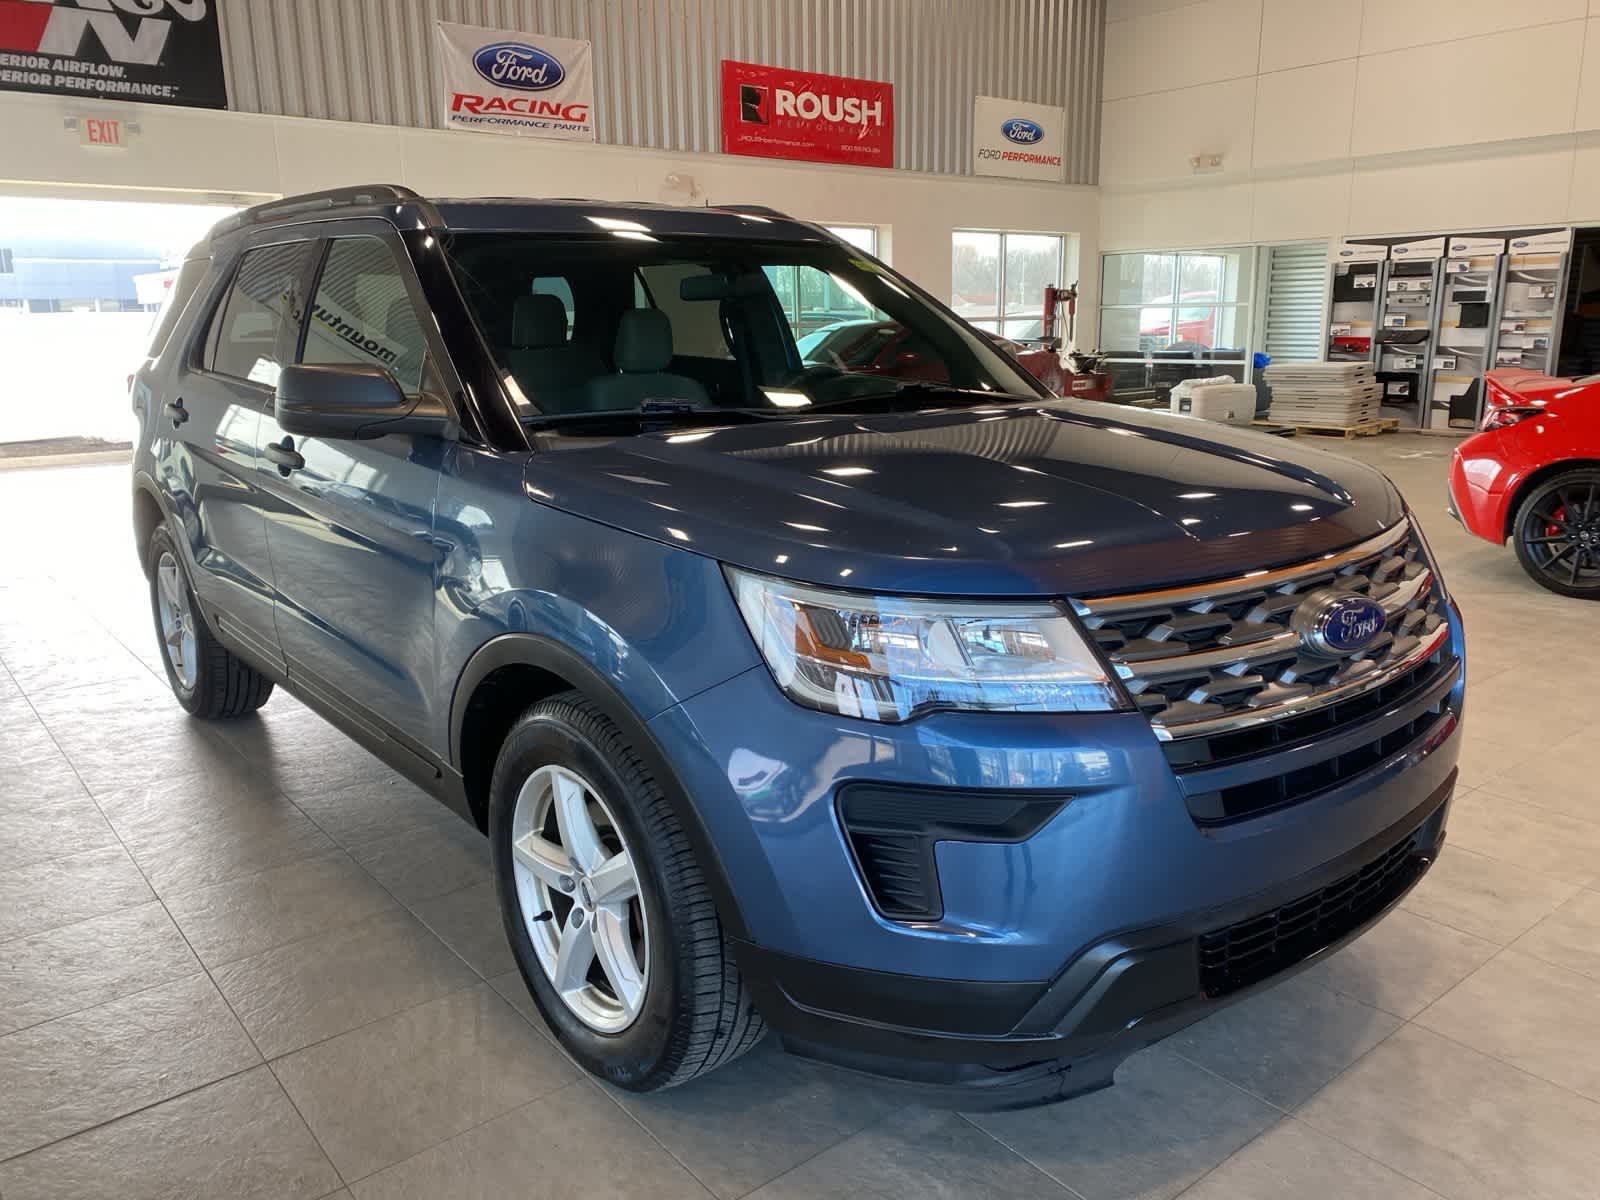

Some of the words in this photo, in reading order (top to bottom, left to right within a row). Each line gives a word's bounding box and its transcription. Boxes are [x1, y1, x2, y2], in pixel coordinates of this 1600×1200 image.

[0, 69, 52, 86] ERIOR
[52, 59, 128, 79] AIRFLOW.
[491, 49, 548, 84] Ford
[451, 92, 589, 123] RACING
[775, 88, 883, 127] ROUSH
[87, 119, 120, 145] EXIT
[451, 115, 551, 129] PERFORMANCE
[553, 123, 590, 132] PARTS
[1009, 122, 1036, 141] Ford
[978, 148, 1001, 160] FORD
[1001, 151, 1062, 167] PERFORMANCE
[1340, 606, 1378, 642] Ford
